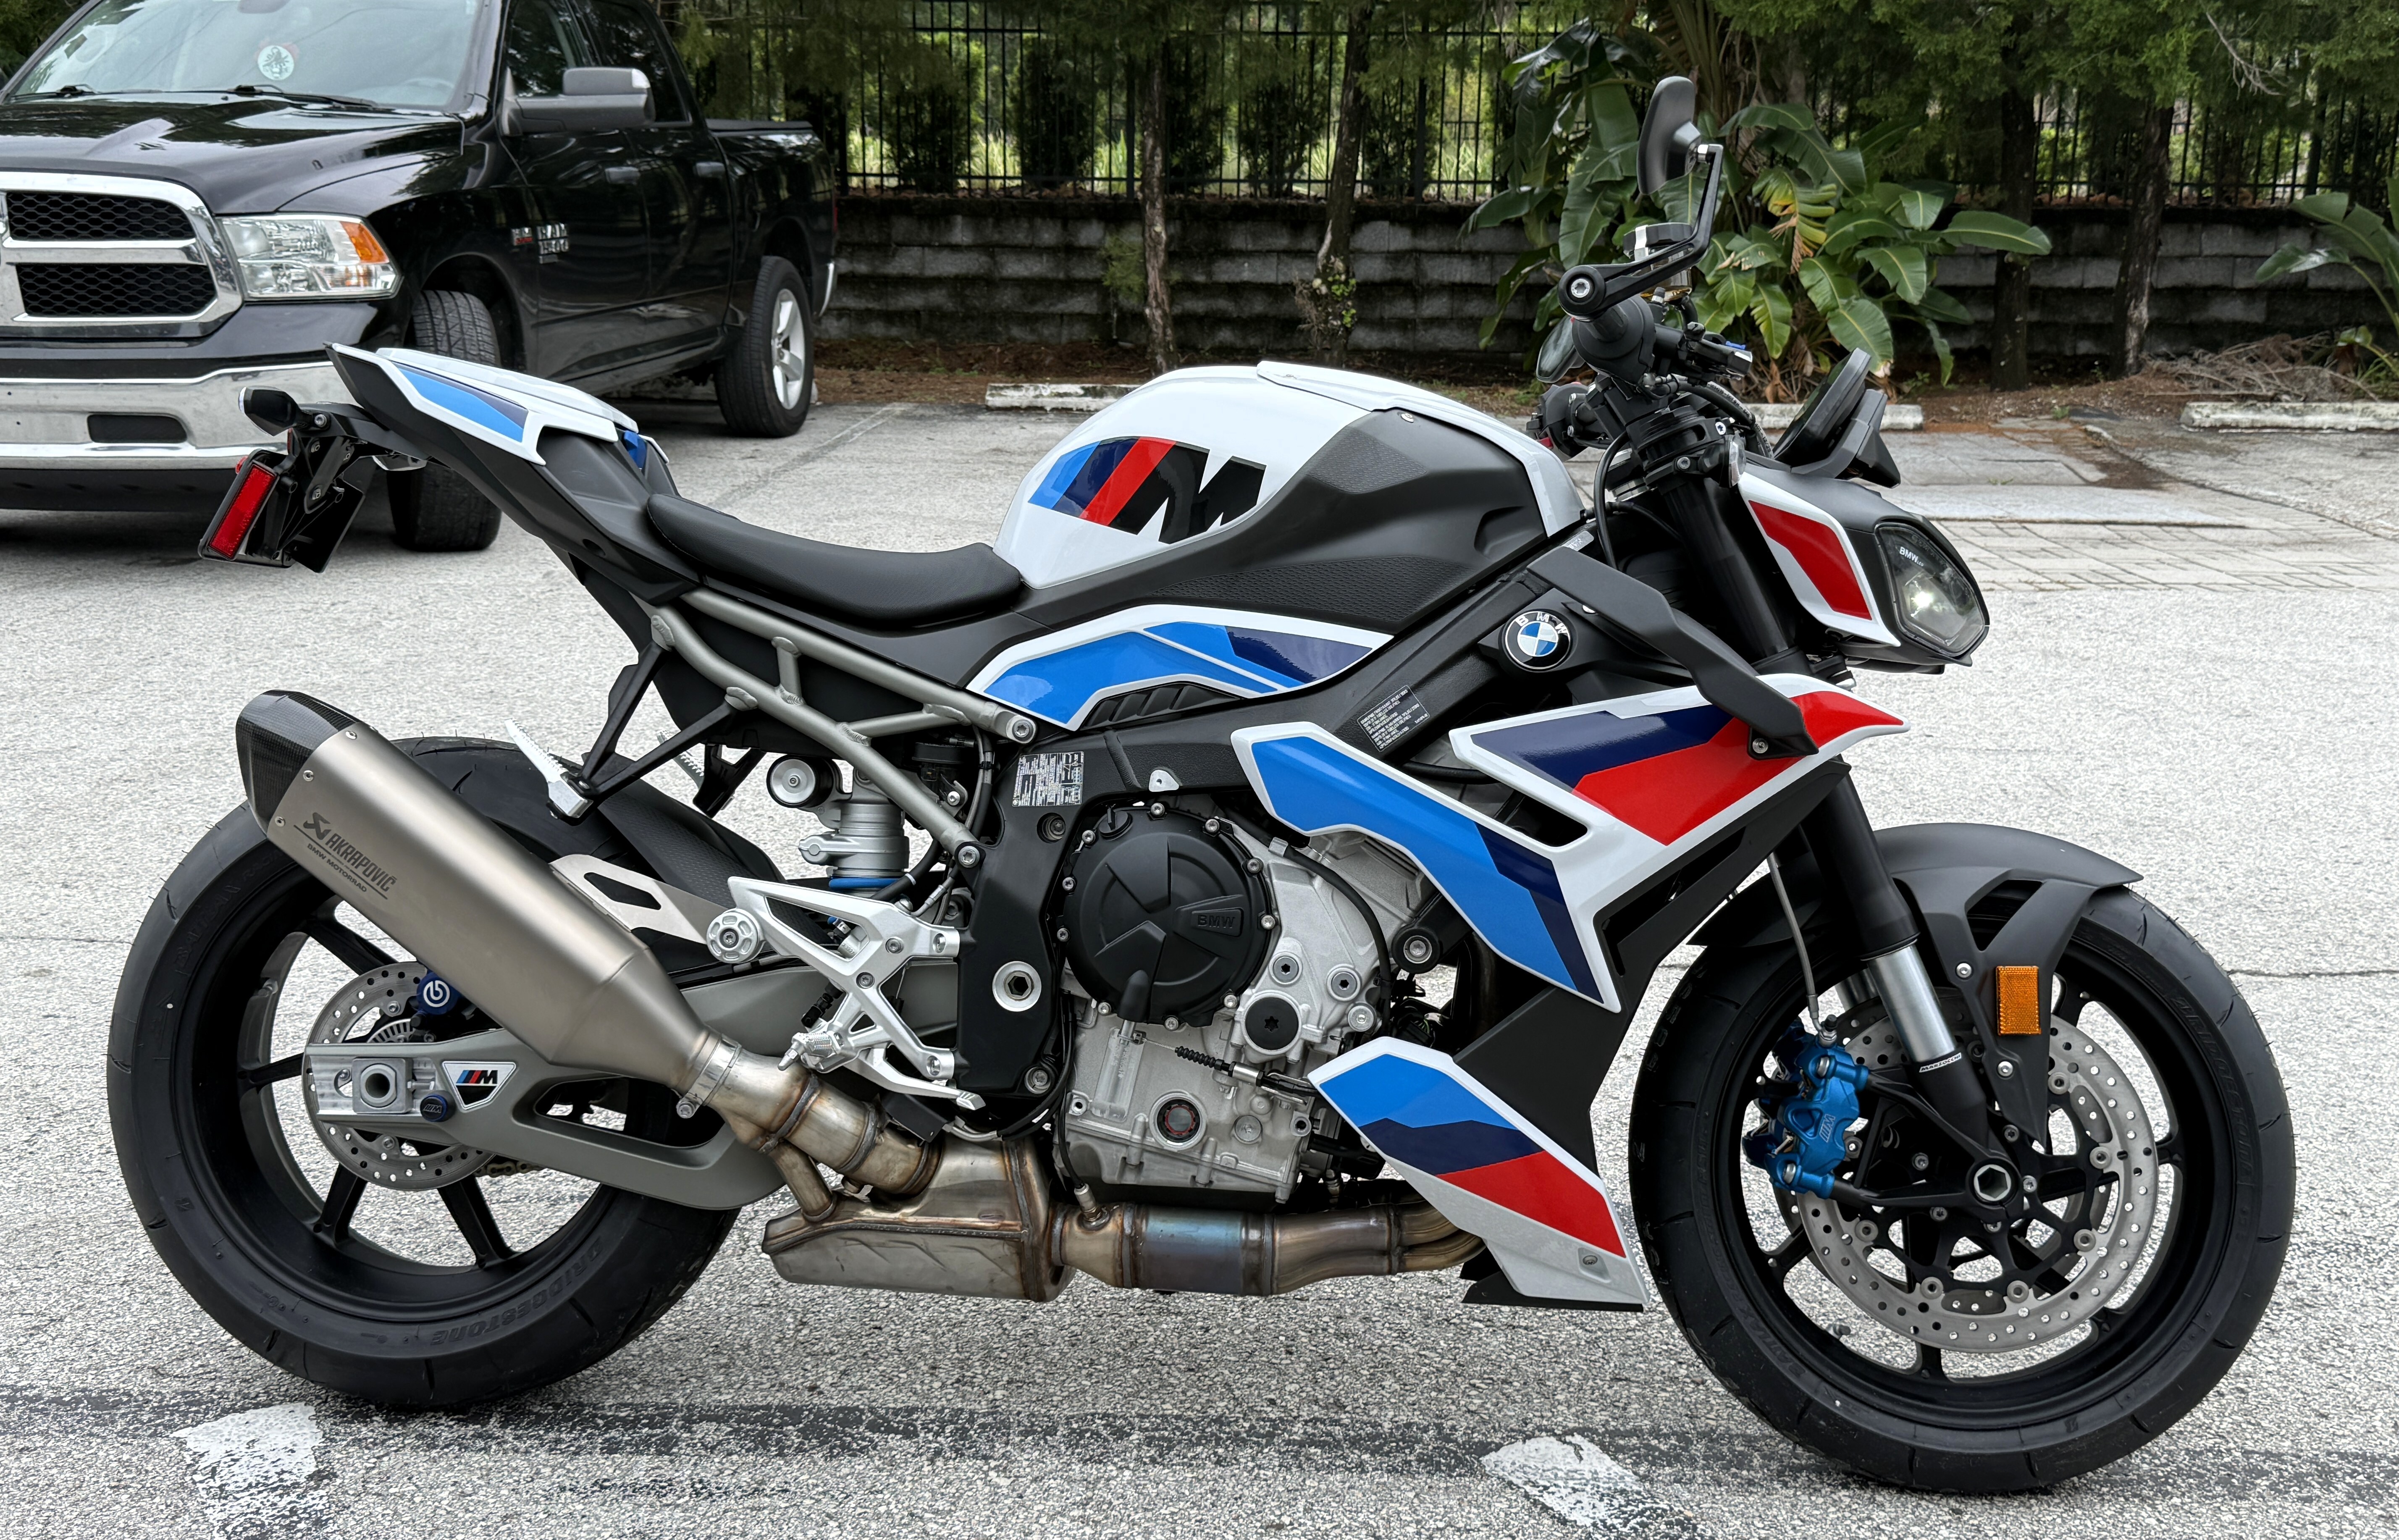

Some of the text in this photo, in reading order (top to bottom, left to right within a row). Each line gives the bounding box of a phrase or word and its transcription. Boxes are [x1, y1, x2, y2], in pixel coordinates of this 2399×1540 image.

[1900, 546, 1918, 563] BMW
[307, 843, 326, 860] BMW
[327, 859, 367, 892] MOTORRAD
[1198, 915, 1236, 929] BMW
[1921, 1055, 1961, 1071] MARZOCCHI
[430, 1236, 602, 1346] BRIDGESTONE
